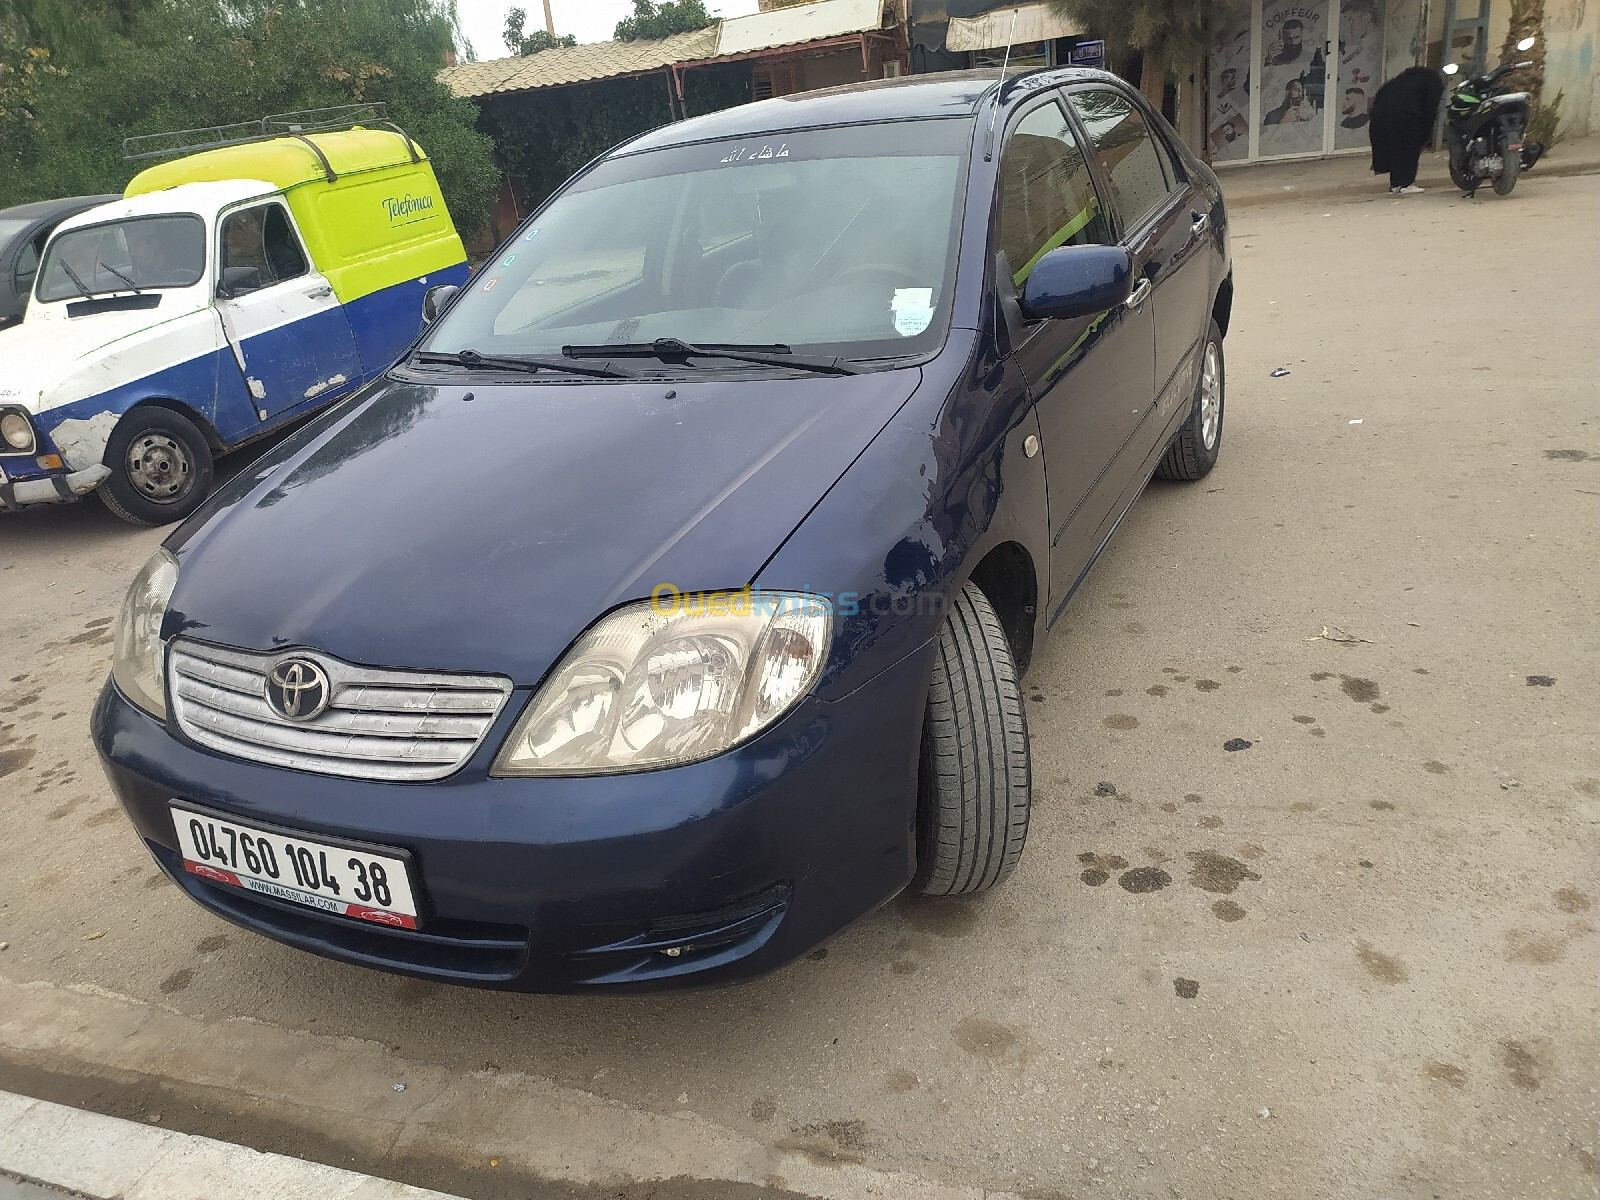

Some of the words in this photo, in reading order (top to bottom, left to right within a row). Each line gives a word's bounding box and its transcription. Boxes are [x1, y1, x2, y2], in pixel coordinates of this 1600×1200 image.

[1266, 8, 1320, 28] COIFFEUR
[720, 145, 746, 162] الله
[775, 143, 790, 157] ما
[189, 819, 280, 878] 04760
[285, 844, 340, 895] 104
[347, 858, 392, 907] 38
[248, 879, 339, 912] WWW.MASSILAR.COM
